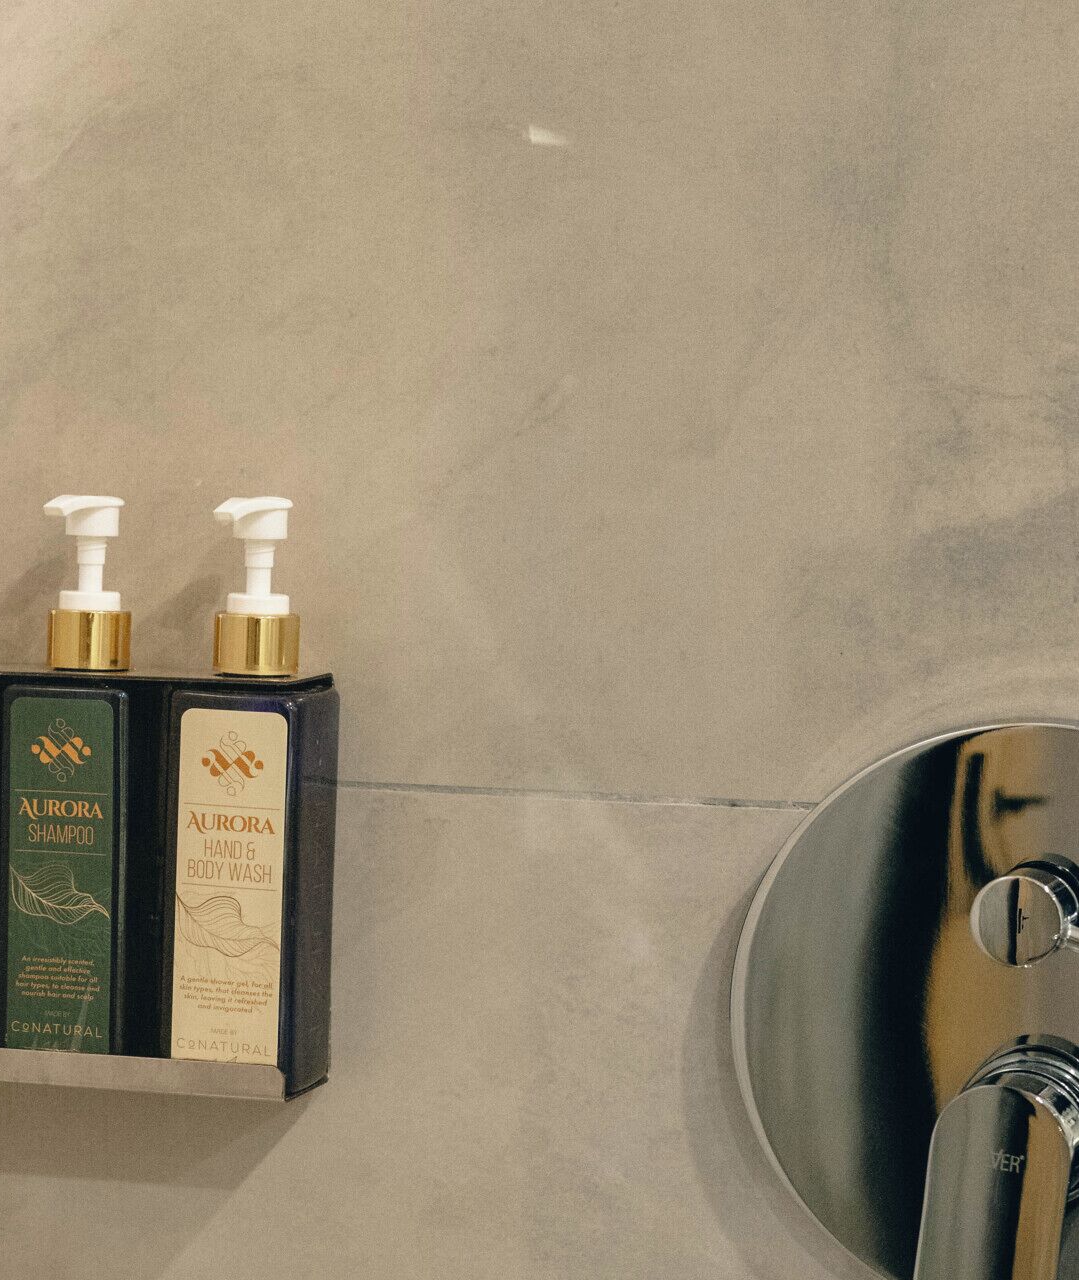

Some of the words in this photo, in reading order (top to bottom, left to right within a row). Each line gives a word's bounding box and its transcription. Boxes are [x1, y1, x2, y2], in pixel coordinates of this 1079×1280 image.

[19, 797, 104, 820] AURORA
[186, 810, 276, 835] AURORA
[28, 823, 94, 845] SHAMPOO
[204, 838, 242, 860] HAND
[246, 841, 256, 860] &
[187, 859, 224, 880] BODY
[228, 862, 272, 883] WASH
[25, 964, 47, 972] gentle
[18, 972, 49, 980] shampoo
[50, 974, 76, 982] suitable
[210, 977, 235, 985] shower
[15, 979, 29, 987] hair
[60, 983, 85, 991] cleanse
[179, 983, 192, 991] skin
[215, 986, 229, 994] that
[231, 988, 260, 997] cleanses
[261, 990, 273, 998] the
[47, 990, 60, 998] hair
[200, 994, 226, 1003] leaving
[234, 997, 268, 1006] refreshed
